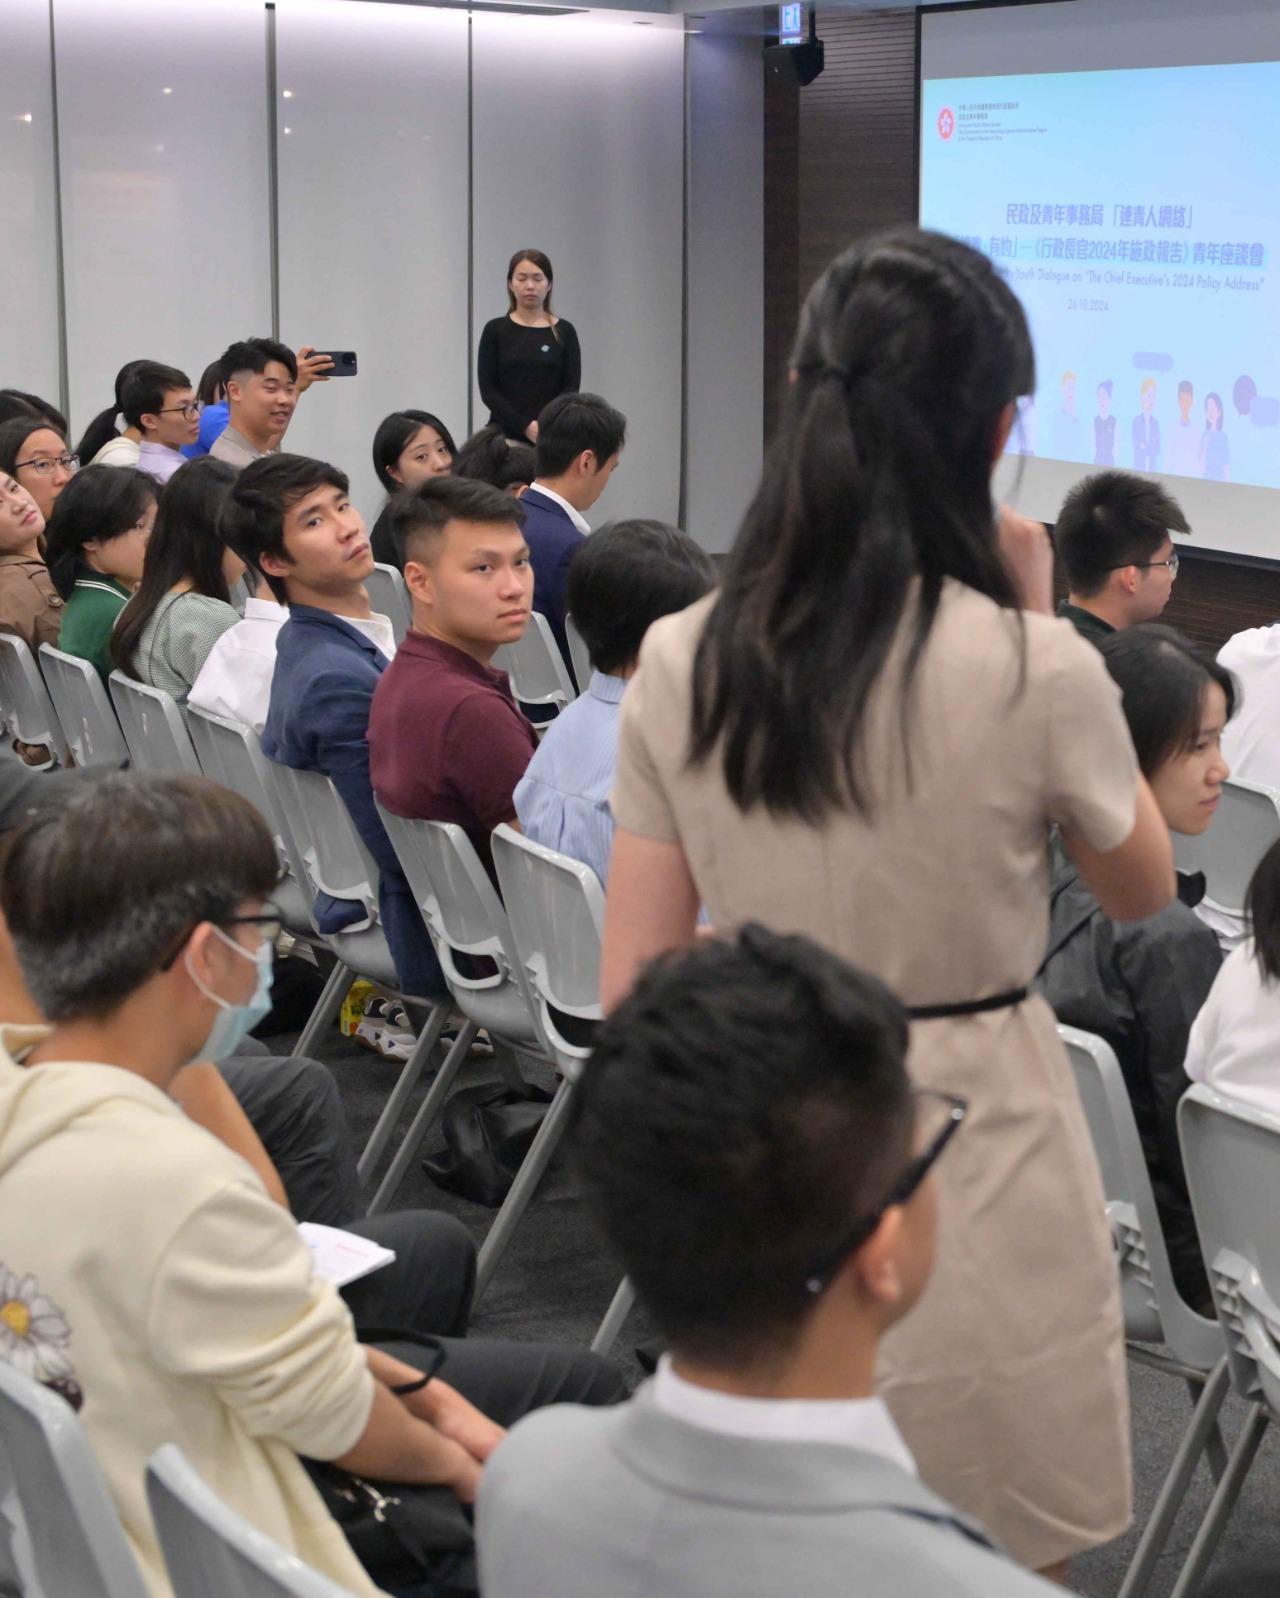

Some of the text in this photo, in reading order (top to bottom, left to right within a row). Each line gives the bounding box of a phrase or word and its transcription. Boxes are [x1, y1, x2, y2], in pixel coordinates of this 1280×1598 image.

[1038, 268, 1070, 284] Dialogue
[1072, 272, 1082, 281] on
[1104, 270, 1125, 284] Chief
[1127, 271, 1170, 287] Executive's
[1172, 273, 1194, 288] 2024
[1197, 274, 1220, 292] Policy
